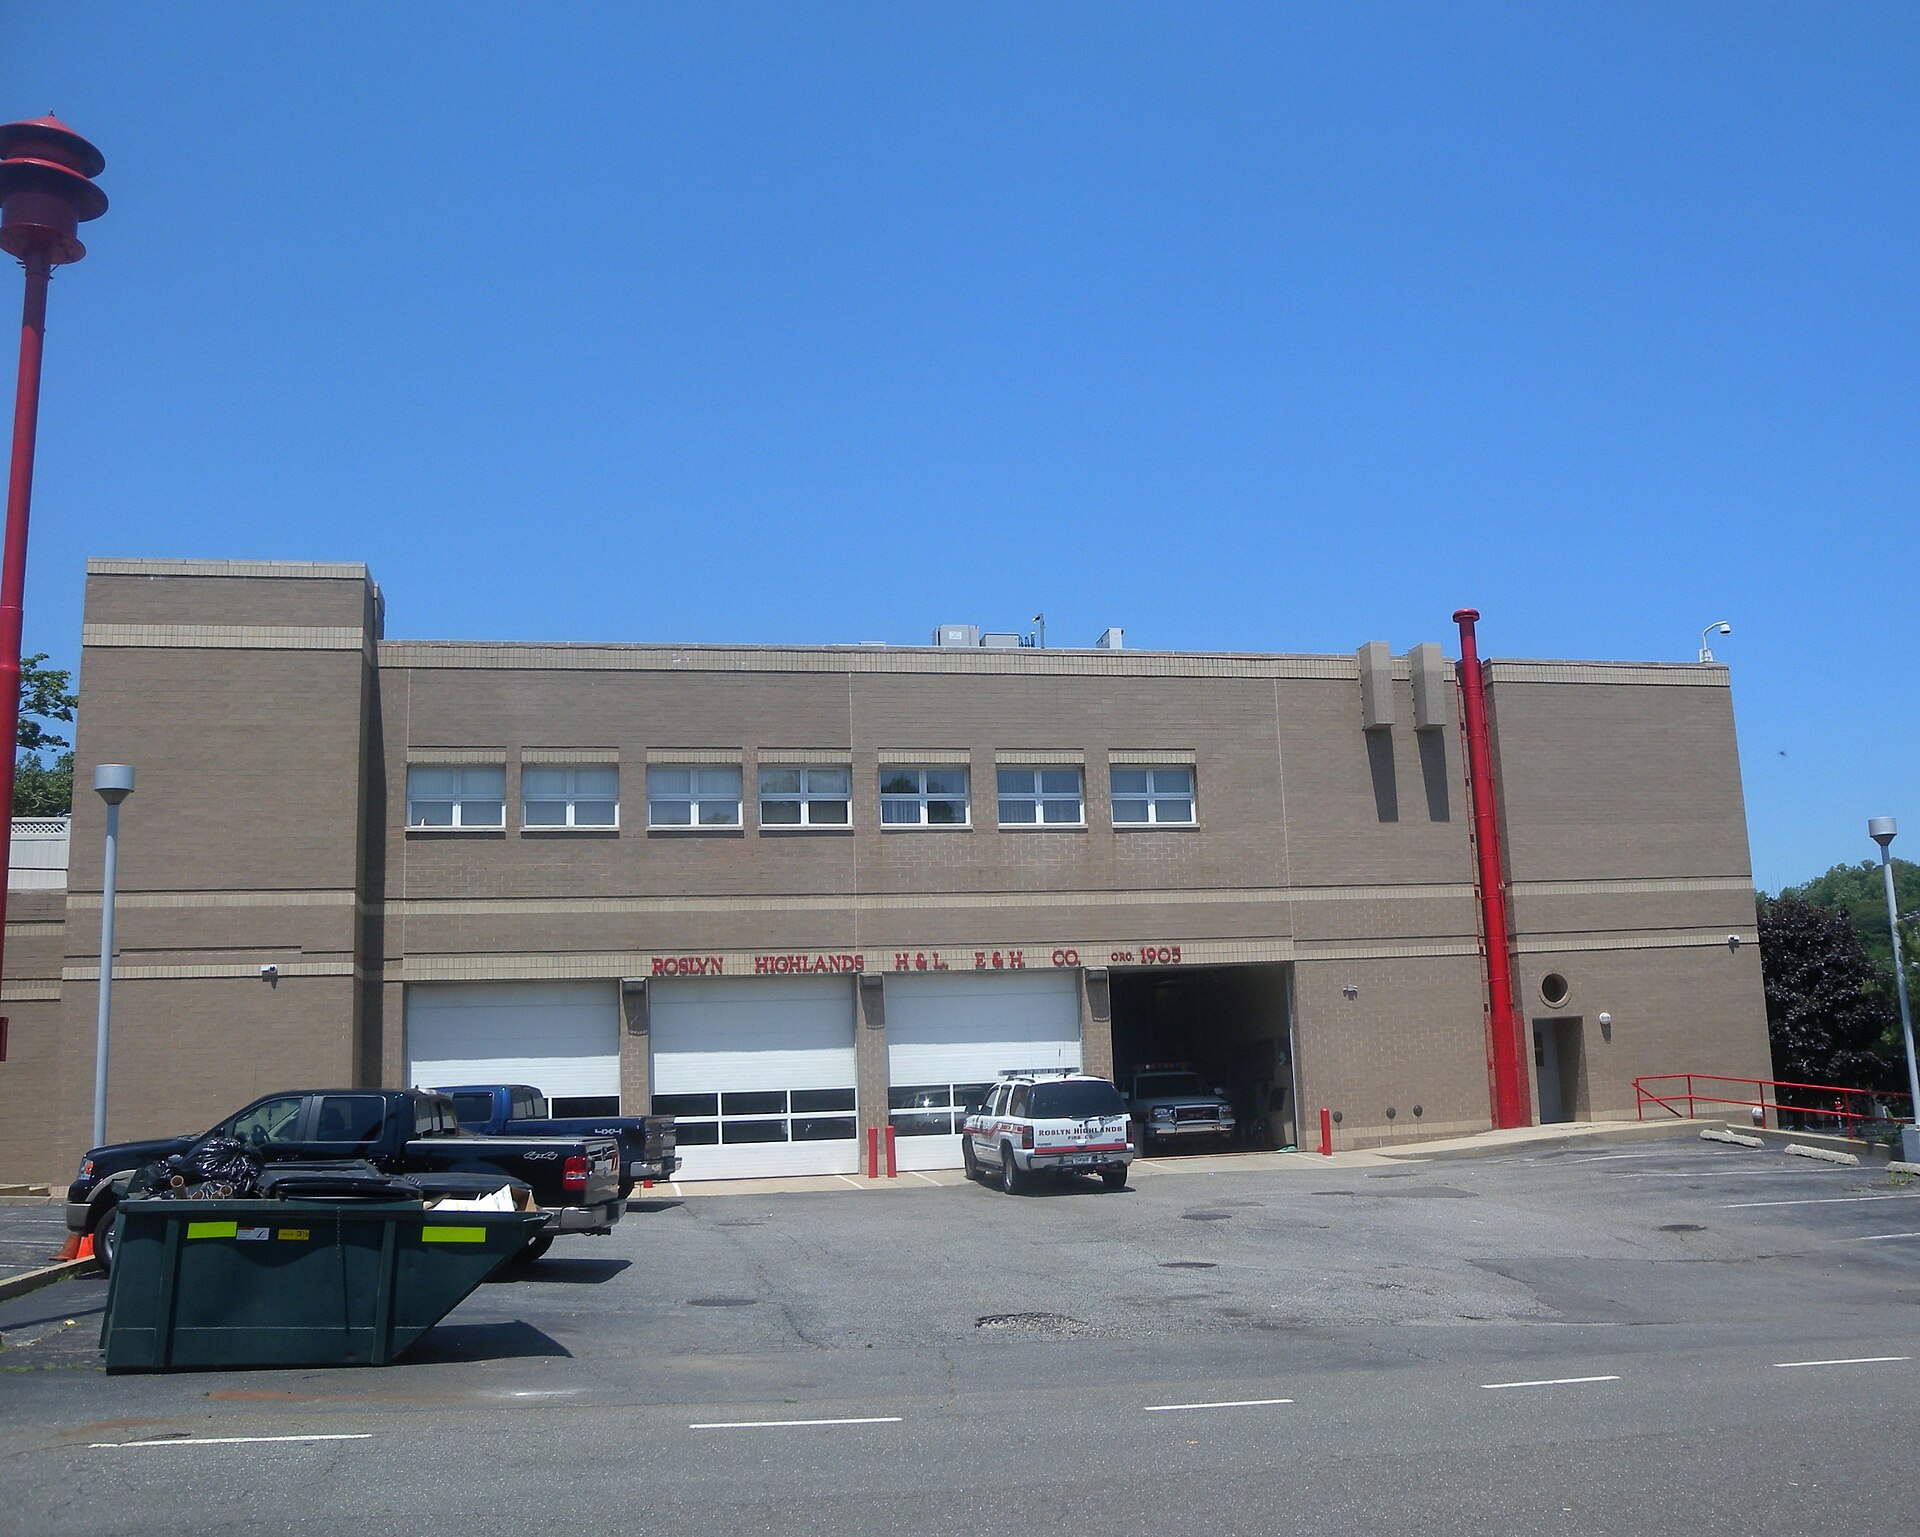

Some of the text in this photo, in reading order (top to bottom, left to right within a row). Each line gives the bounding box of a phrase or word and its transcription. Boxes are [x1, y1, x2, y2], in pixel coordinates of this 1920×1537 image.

[651, 957, 723, 976] ROSLYN
[754, 954, 865, 974] HIGHLANDS
[895, 951, 909, 971] H
[916, 951, 927, 971] &
[975, 951, 986, 970] E
[992, 950, 1004, 970] &
[1141, 946, 1182, 964] 1905
[1039, 1126, 1123, 1136] ROSLYN HIGHLANDS
